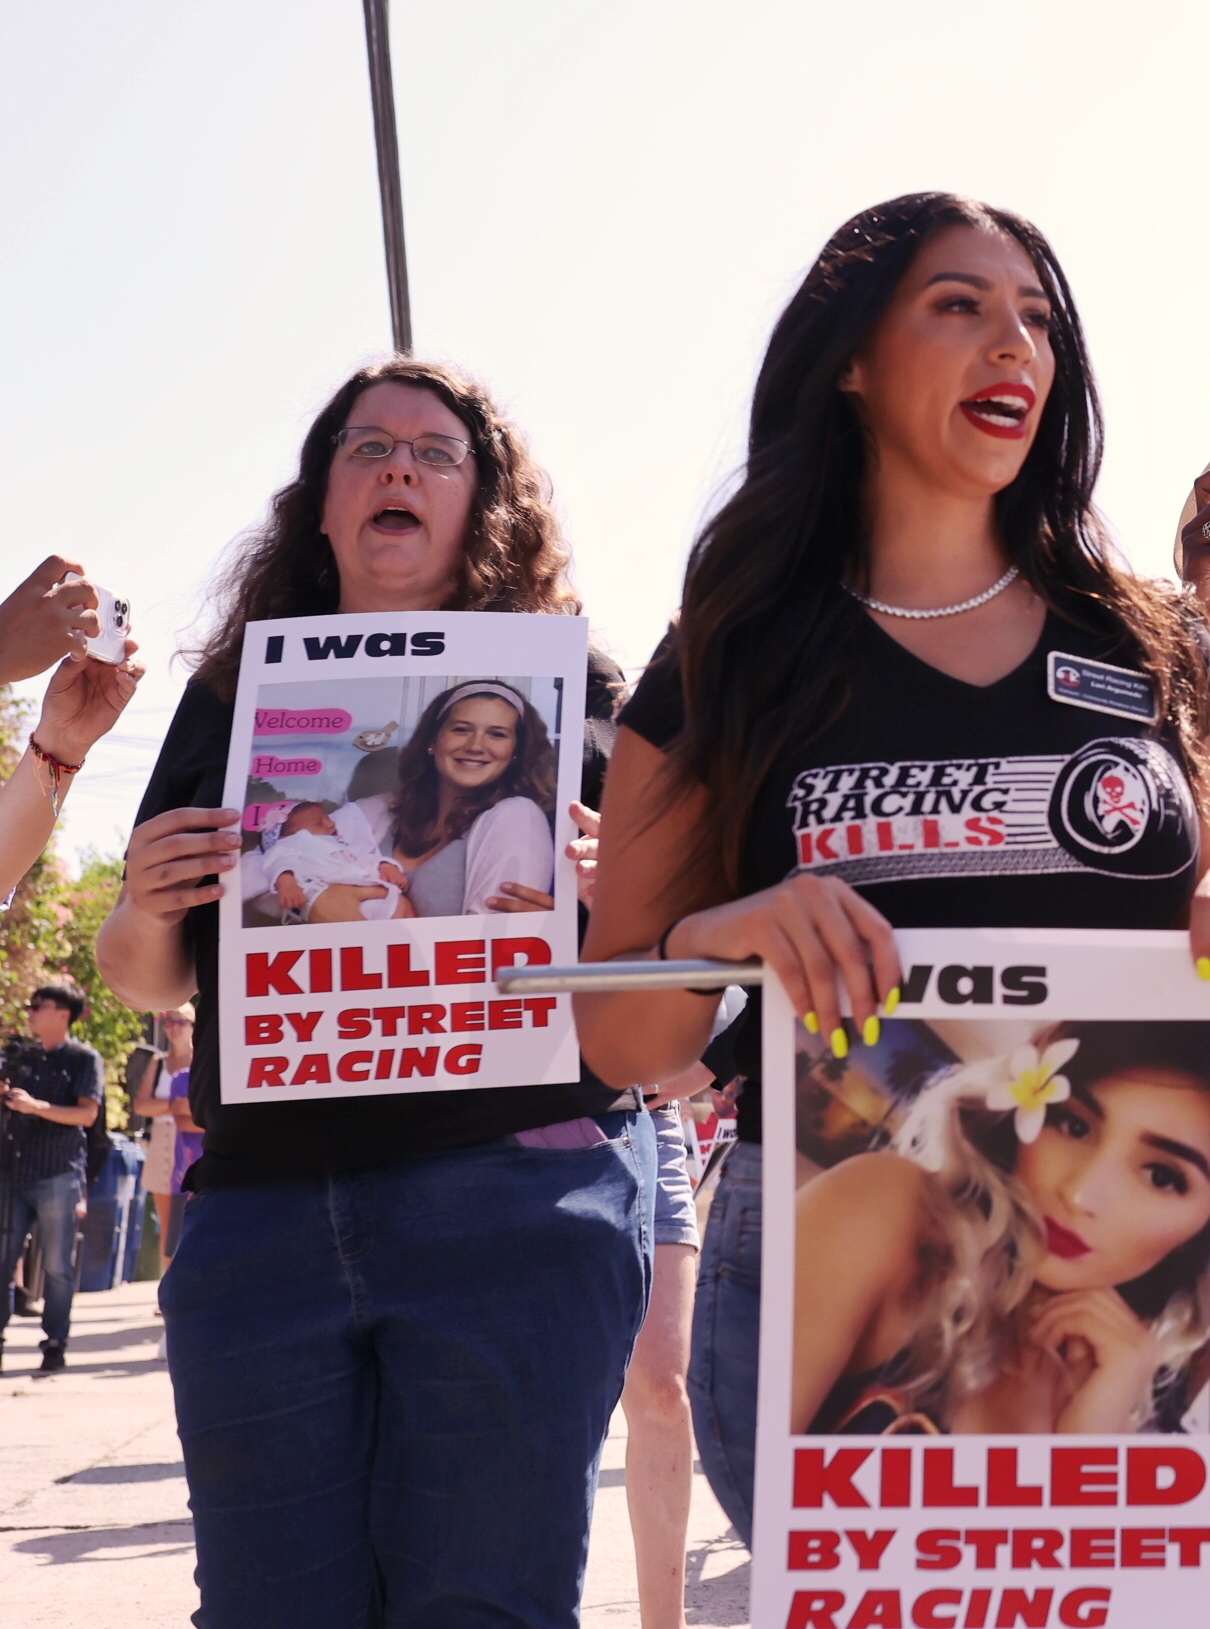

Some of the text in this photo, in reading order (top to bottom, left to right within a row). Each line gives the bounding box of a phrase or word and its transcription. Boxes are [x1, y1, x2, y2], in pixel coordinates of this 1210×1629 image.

[264, 631, 446, 665] I was
[255, 757, 318, 774] Home
[793, 761, 1002, 801] STREET
[797, 787, 1011, 830] RACING
[800, 815, 1006, 865] KILLS
[246, 936, 552, 998] KILLED
[245, 997, 557, 1046] BY STREET
[247, 1043, 483, 1089] RACING
[792, 1446, 1208, 1509] KILLED
[787, 1529, 897, 1572] BY
[786, 1586, 1112, 1629] RACING
